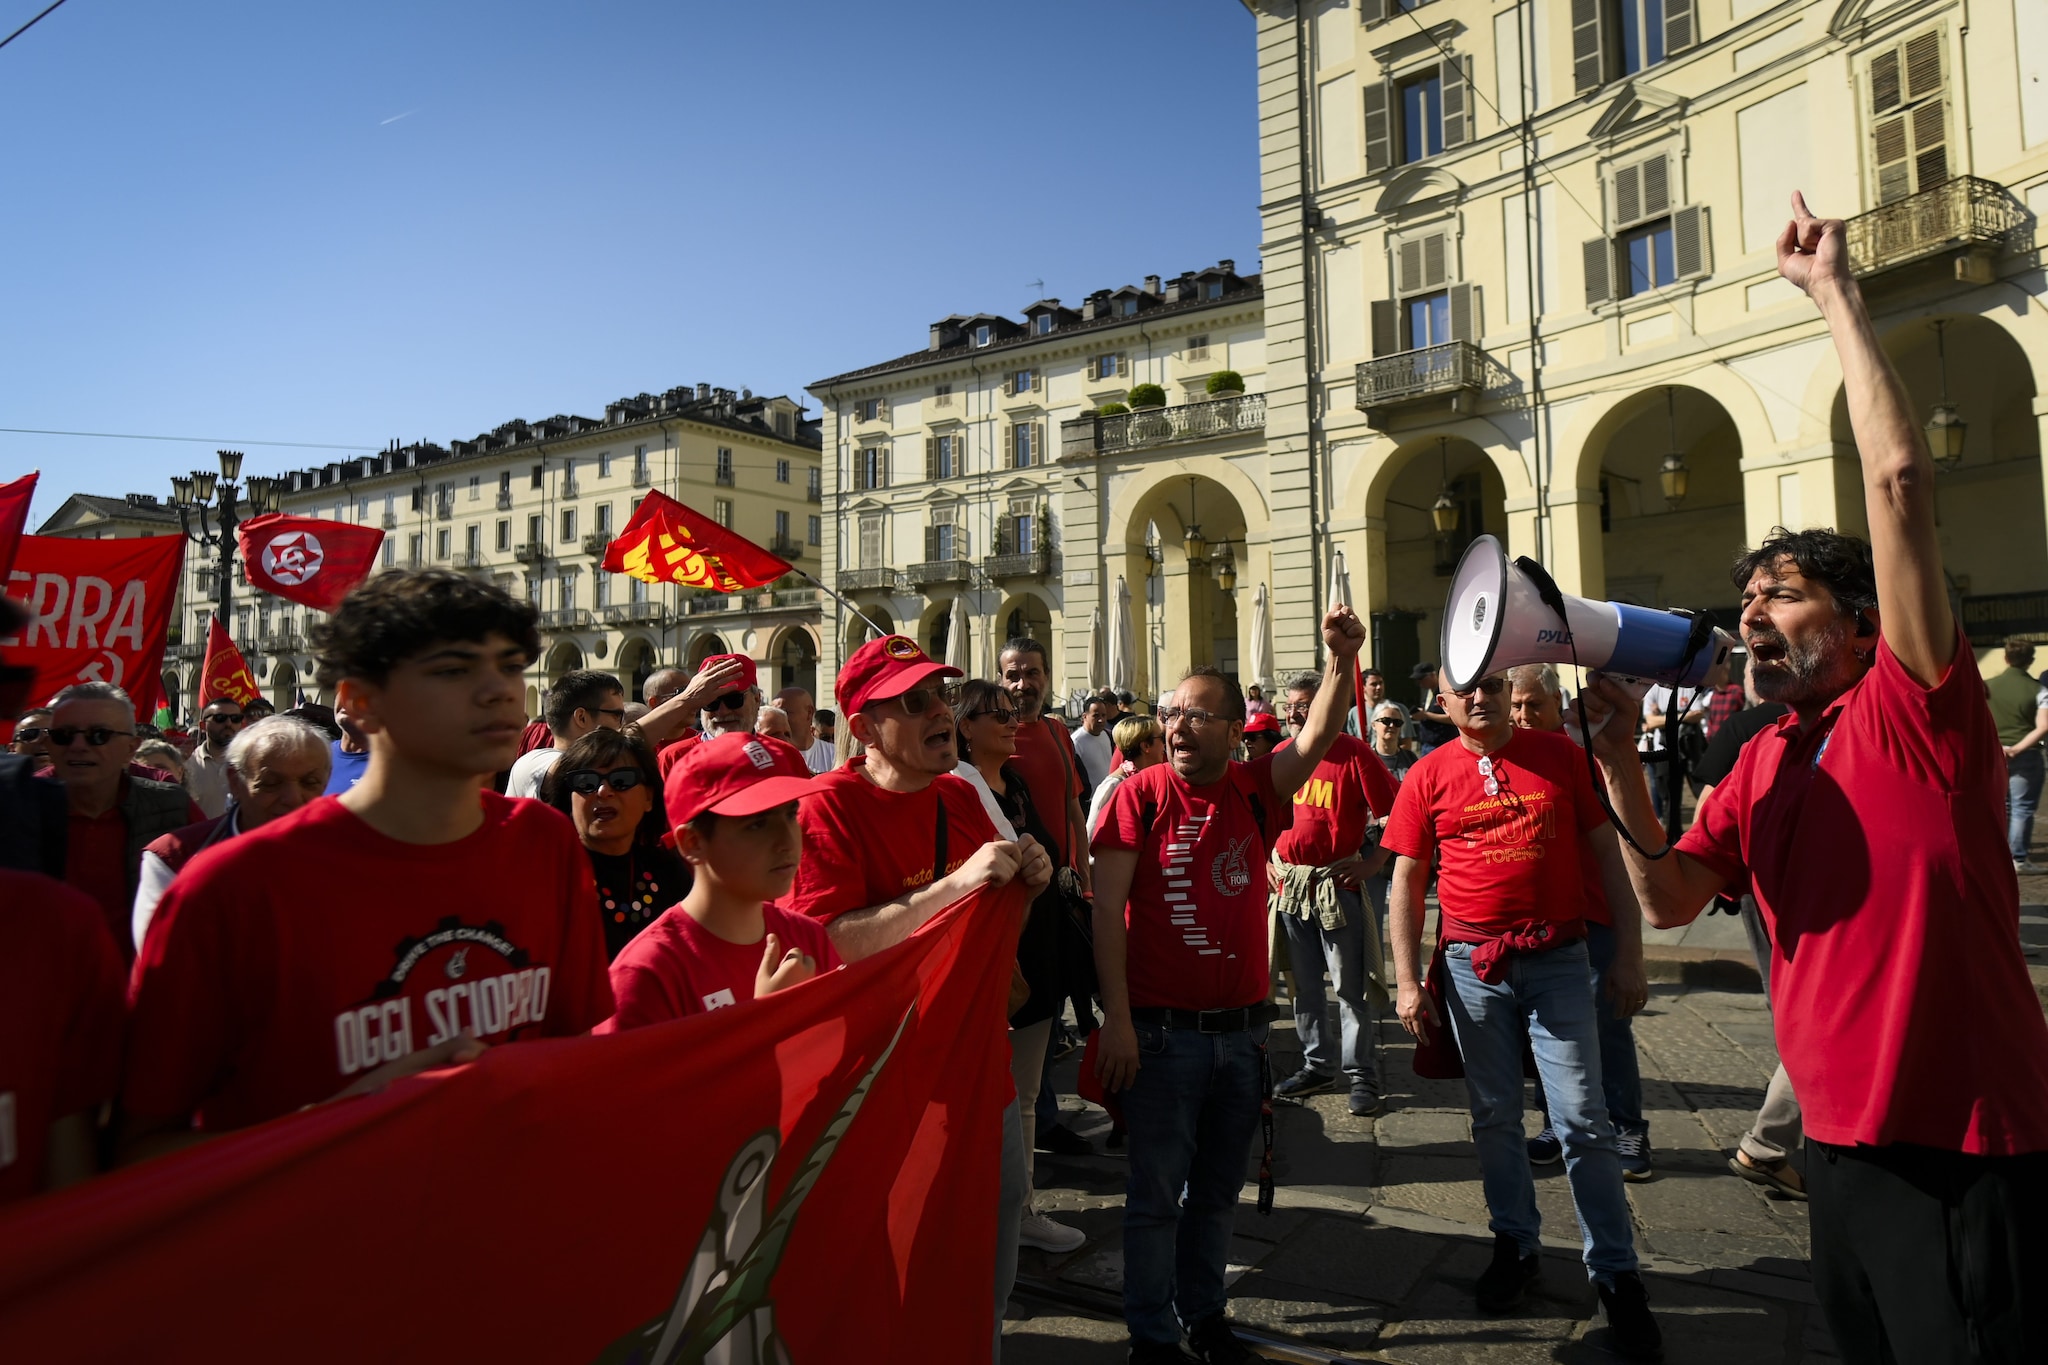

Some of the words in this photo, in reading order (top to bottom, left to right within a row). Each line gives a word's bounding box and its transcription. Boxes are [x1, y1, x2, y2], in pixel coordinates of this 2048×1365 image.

[1537, 629, 1574, 645] PYLE
[1293, 779, 1334, 809] OM
[1459, 802, 1557, 845] FIOM
[1482, 845, 1546, 865] TORINO
[1230, 874, 1249, 886] FIOM
[334, 996, 414, 1076] OGGI
